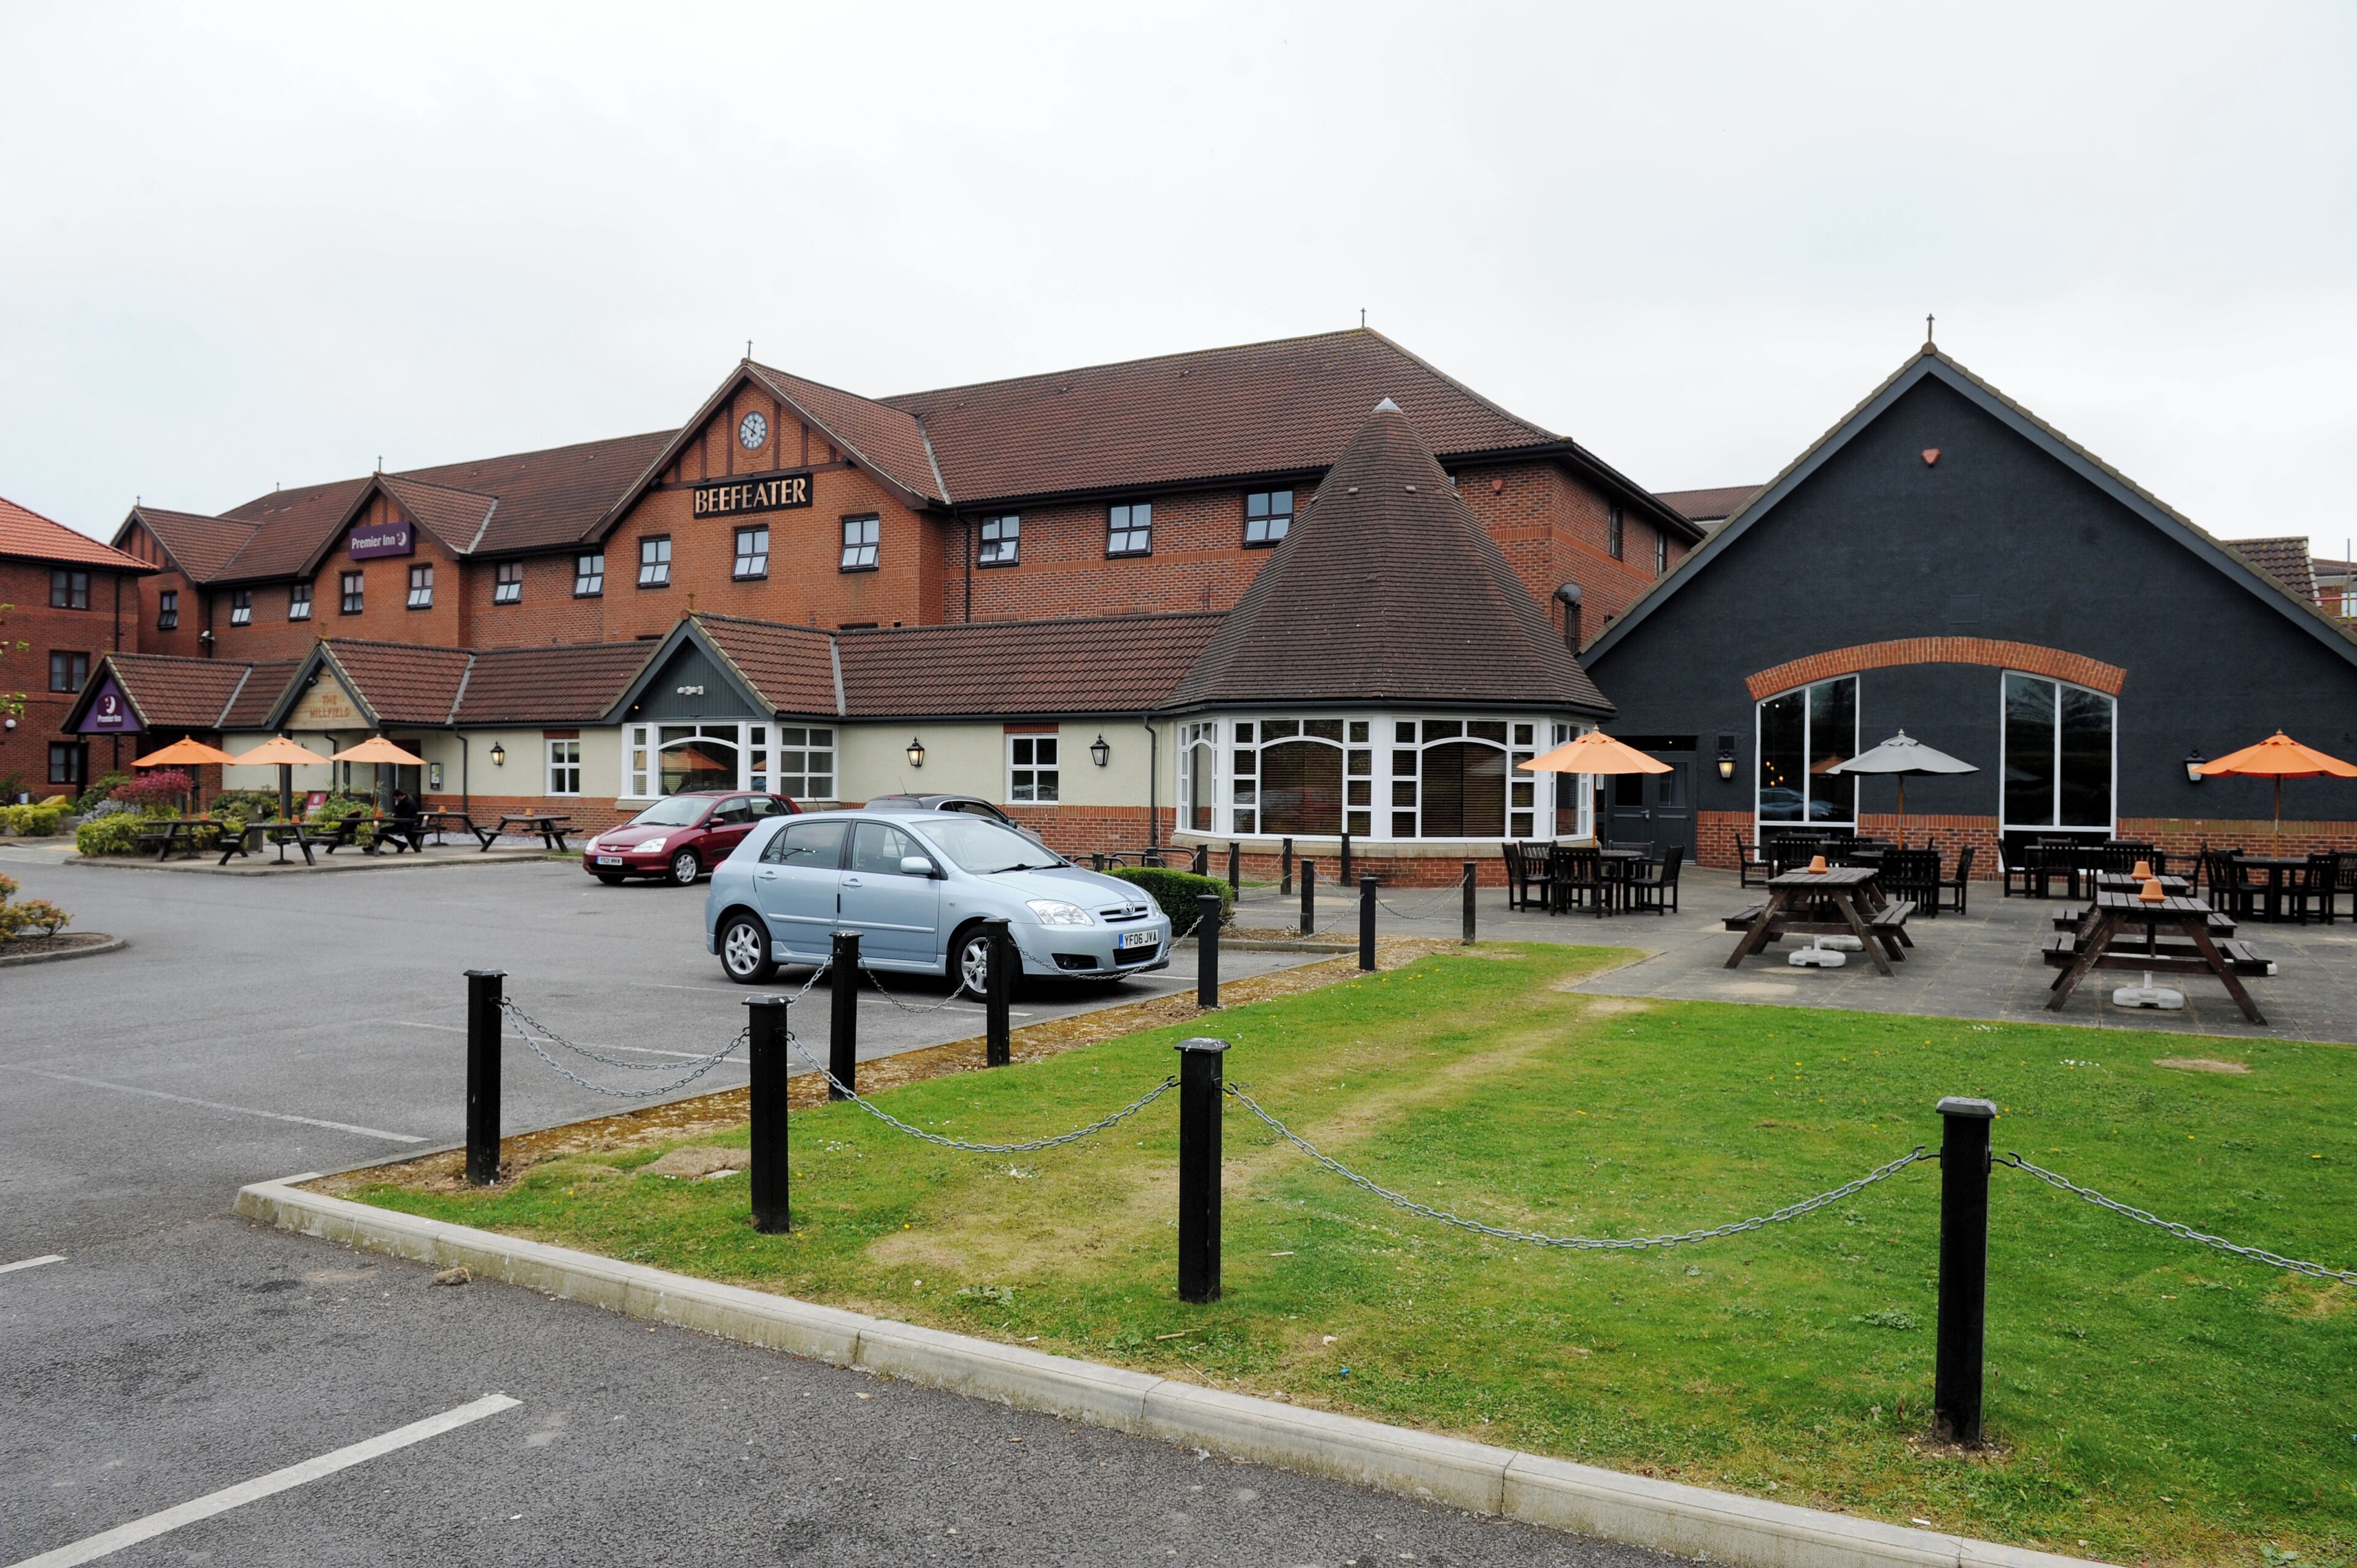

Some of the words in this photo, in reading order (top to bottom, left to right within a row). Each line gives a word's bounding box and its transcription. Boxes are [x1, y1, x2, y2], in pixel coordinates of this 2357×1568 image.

[695, 477, 807, 514] BEEFEATER
[351, 535, 382, 550] Premier
[382, 534, 396, 546] Inn
[322, 694, 338, 705] THE
[1124, 933, 1143, 946] YF06
[1144, 931, 1157, 943] JVA
